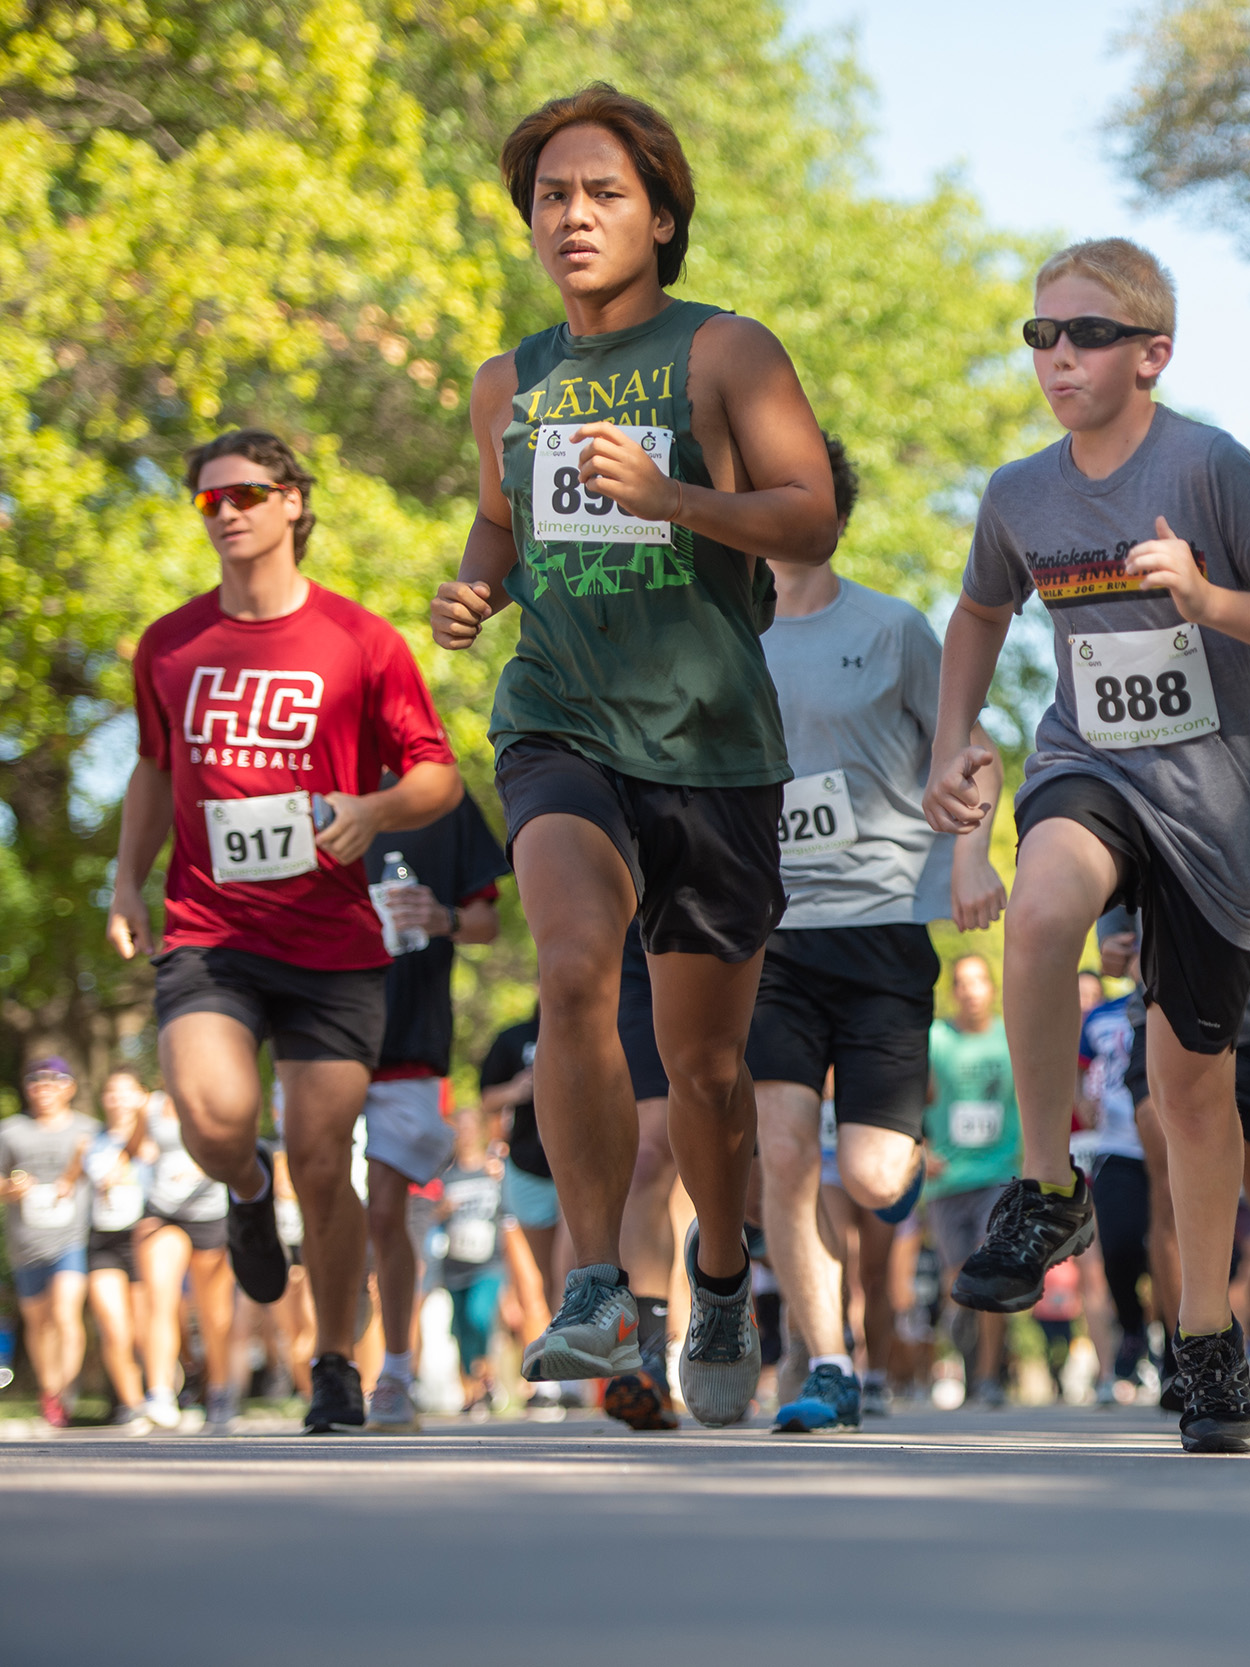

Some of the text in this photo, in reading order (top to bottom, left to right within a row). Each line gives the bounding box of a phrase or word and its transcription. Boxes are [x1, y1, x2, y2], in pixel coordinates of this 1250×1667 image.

[551, 466, 637, 517] 89
[538, 520, 661, 536] timerguys.com
[1025, 547, 1109, 571] Manickam
[1074, 581, 1095, 594] JOG
[1107, 581, 1128, 590] RUN
[183, 666, 325, 750] HC
[1095, 670, 1192, 723] 888
[1086, 716, 1211, 743] timerguys.com
[190, 748, 314, 770] BASEBALL
[226, 826, 294, 863] 917
